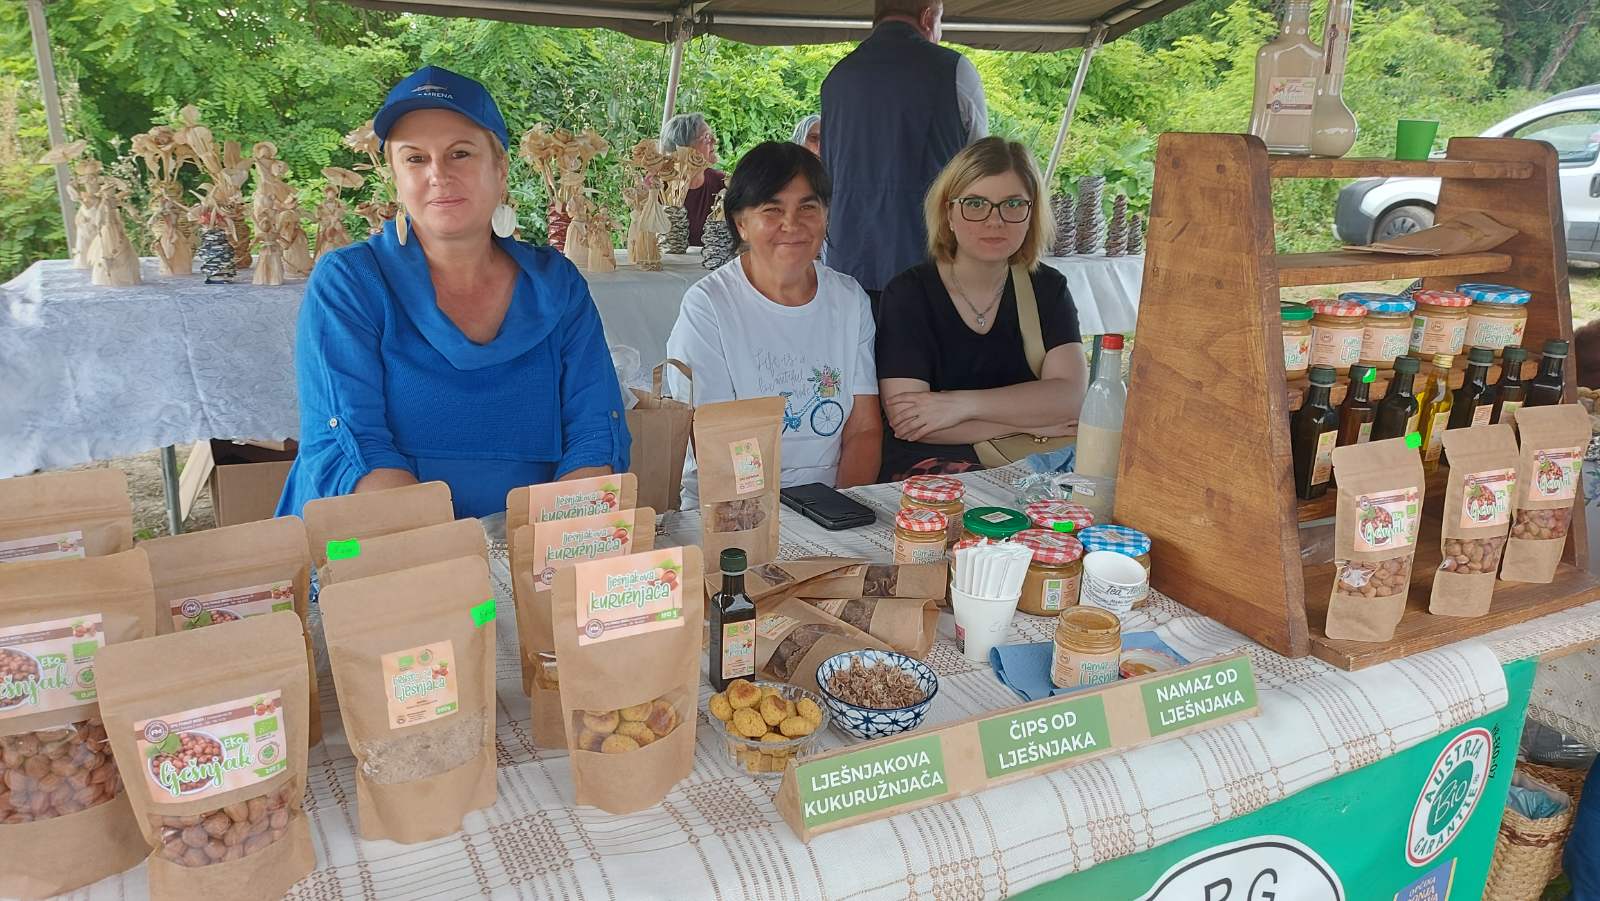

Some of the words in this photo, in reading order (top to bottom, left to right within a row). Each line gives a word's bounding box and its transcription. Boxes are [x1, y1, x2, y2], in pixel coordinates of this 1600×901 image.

[1156, 674, 1214, 702] NAMAZ
[1215, 668, 1238, 686] OD
[1009, 719, 1049, 740] ČIPS
[1051, 711, 1077, 730] OD
[1160, 689, 1245, 726] LJEŠNJAKA
[224, 736, 244, 748] EKO
[998, 731, 1097, 769] LJEŠNJAKA
[811, 751, 931, 791] LJEŠNJAKOVA
[1424, 736, 1484, 803] AUSTRIA
[804, 769, 945, 818] KUKURUŽNJAČA
[1432, 779, 1468, 826] Bio
[1413, 786, 1479, 856] GARANTIE
